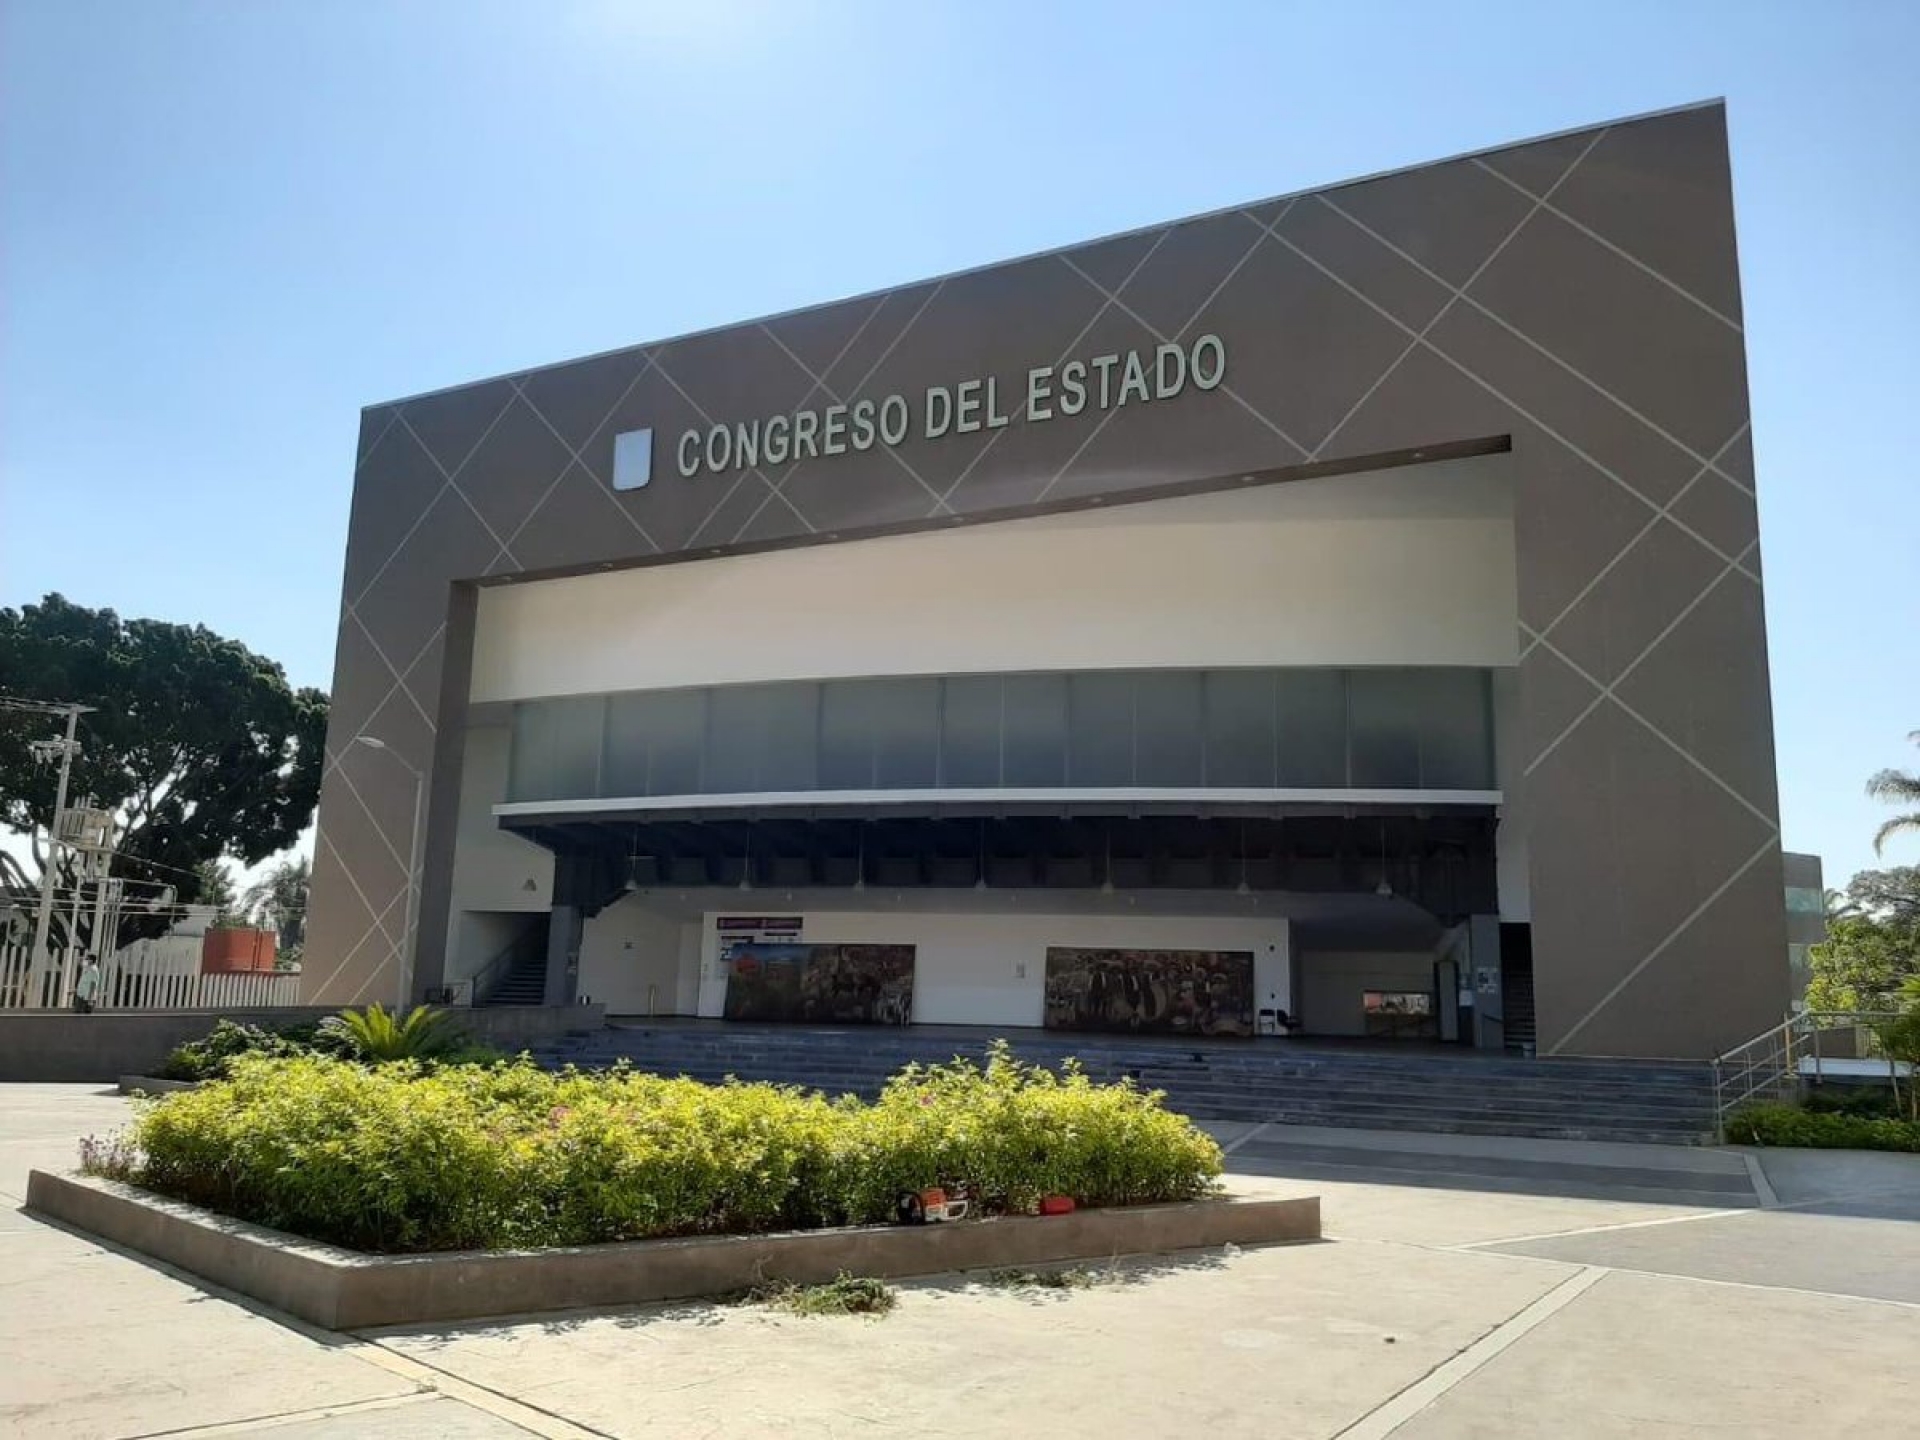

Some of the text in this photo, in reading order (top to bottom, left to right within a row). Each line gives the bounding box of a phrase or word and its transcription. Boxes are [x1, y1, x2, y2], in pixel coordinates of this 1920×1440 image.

[677, 333, 1226, 477] CONGRESO DEL ESTADO
